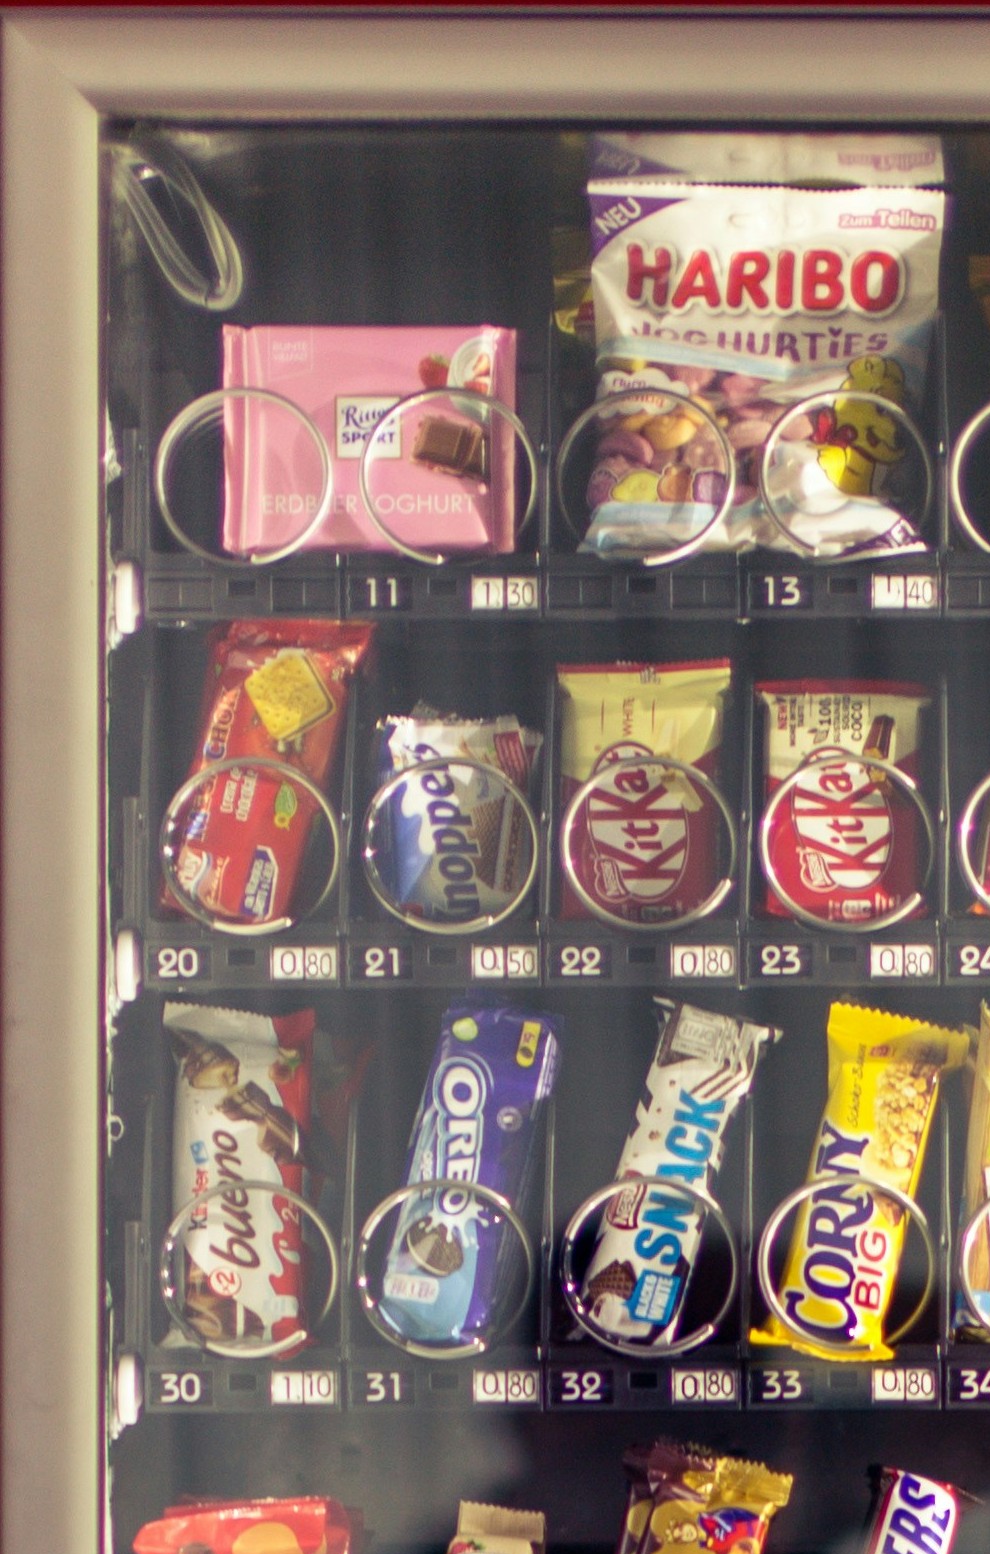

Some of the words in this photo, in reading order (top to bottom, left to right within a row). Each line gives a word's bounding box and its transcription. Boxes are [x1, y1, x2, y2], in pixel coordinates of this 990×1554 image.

[593, 196, 644, 237] NEU
[840, 214, 875, 228] Zum
[876, 210, 936, 231] Teilen
[626, 242, 902, 314] HARIBO
[366, 494, 476, 515] OGHURT
[365, 580, 399, 607] 11
[764, 577, 801, 606] 13
[158, 948, 199, 977] 20
[365, 948, 400, 976] 21
[560, 947, 601, 976] 22
[761, 947, 801, 975] 23
[441, 1064, 481, 1216] OREO
[634, 1088, 727, 1266] SNACK
[209, 1129, 261, 1269] bueno
[784, 1119, 875, 1344] CORNY
[854, 1230, 887, 1310] BIG
[160, 1373, 201, 1402] 30
[366, 1373, 400, 1401] 31
[560, 1372, 602, 1400] 32
[762, 1371, 802, 1399] 33
